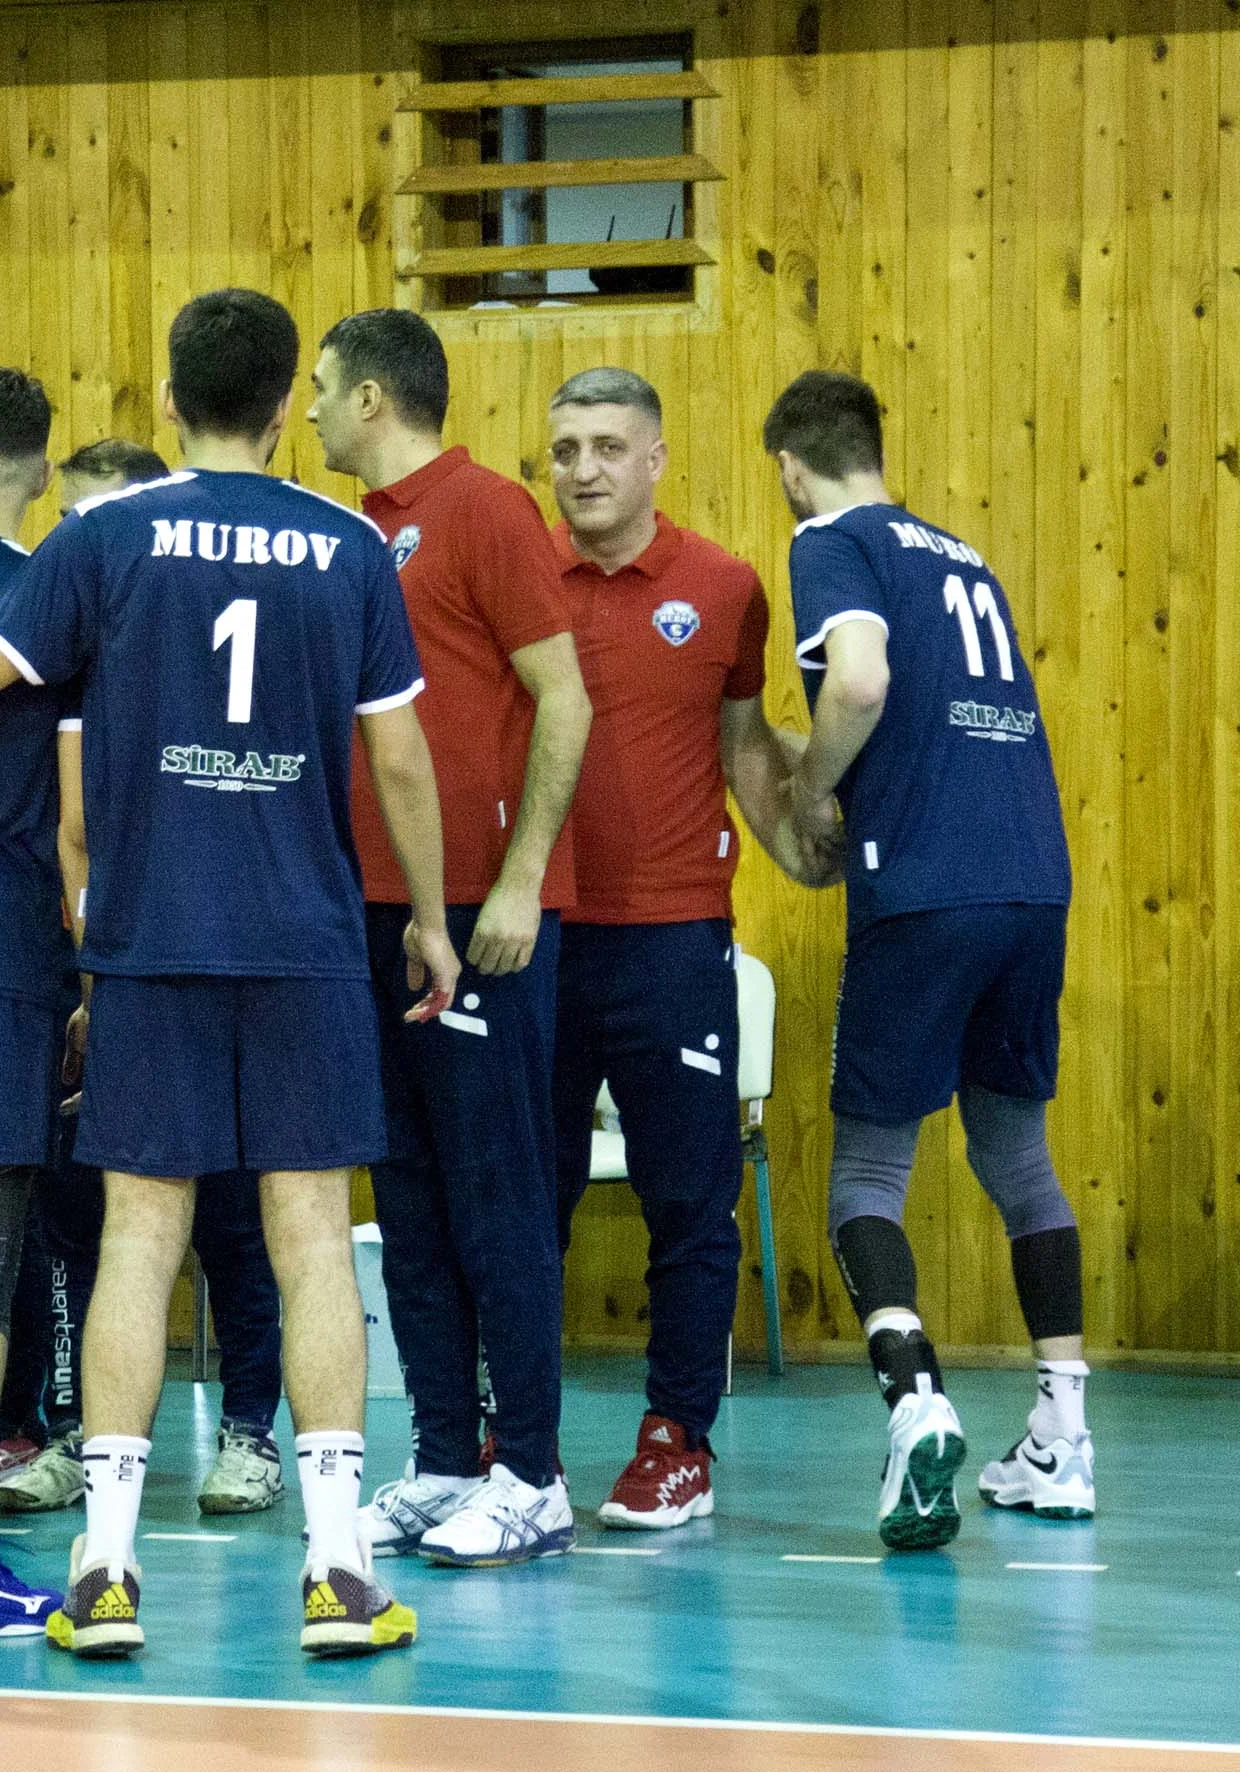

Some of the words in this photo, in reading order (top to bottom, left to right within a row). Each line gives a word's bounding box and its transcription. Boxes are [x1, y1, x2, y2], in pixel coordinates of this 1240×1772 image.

[151, 519, 341, 571] MUROV
[887, 521, 995, 575] MURO
[943, 573, 1015, 682] 11
[213, 598, 258, 724] 1
[113, 1455, 134, 1482] nine
[313, 1449, 337, 1476] nine
[91, 1603, 136, 1620] adidas
